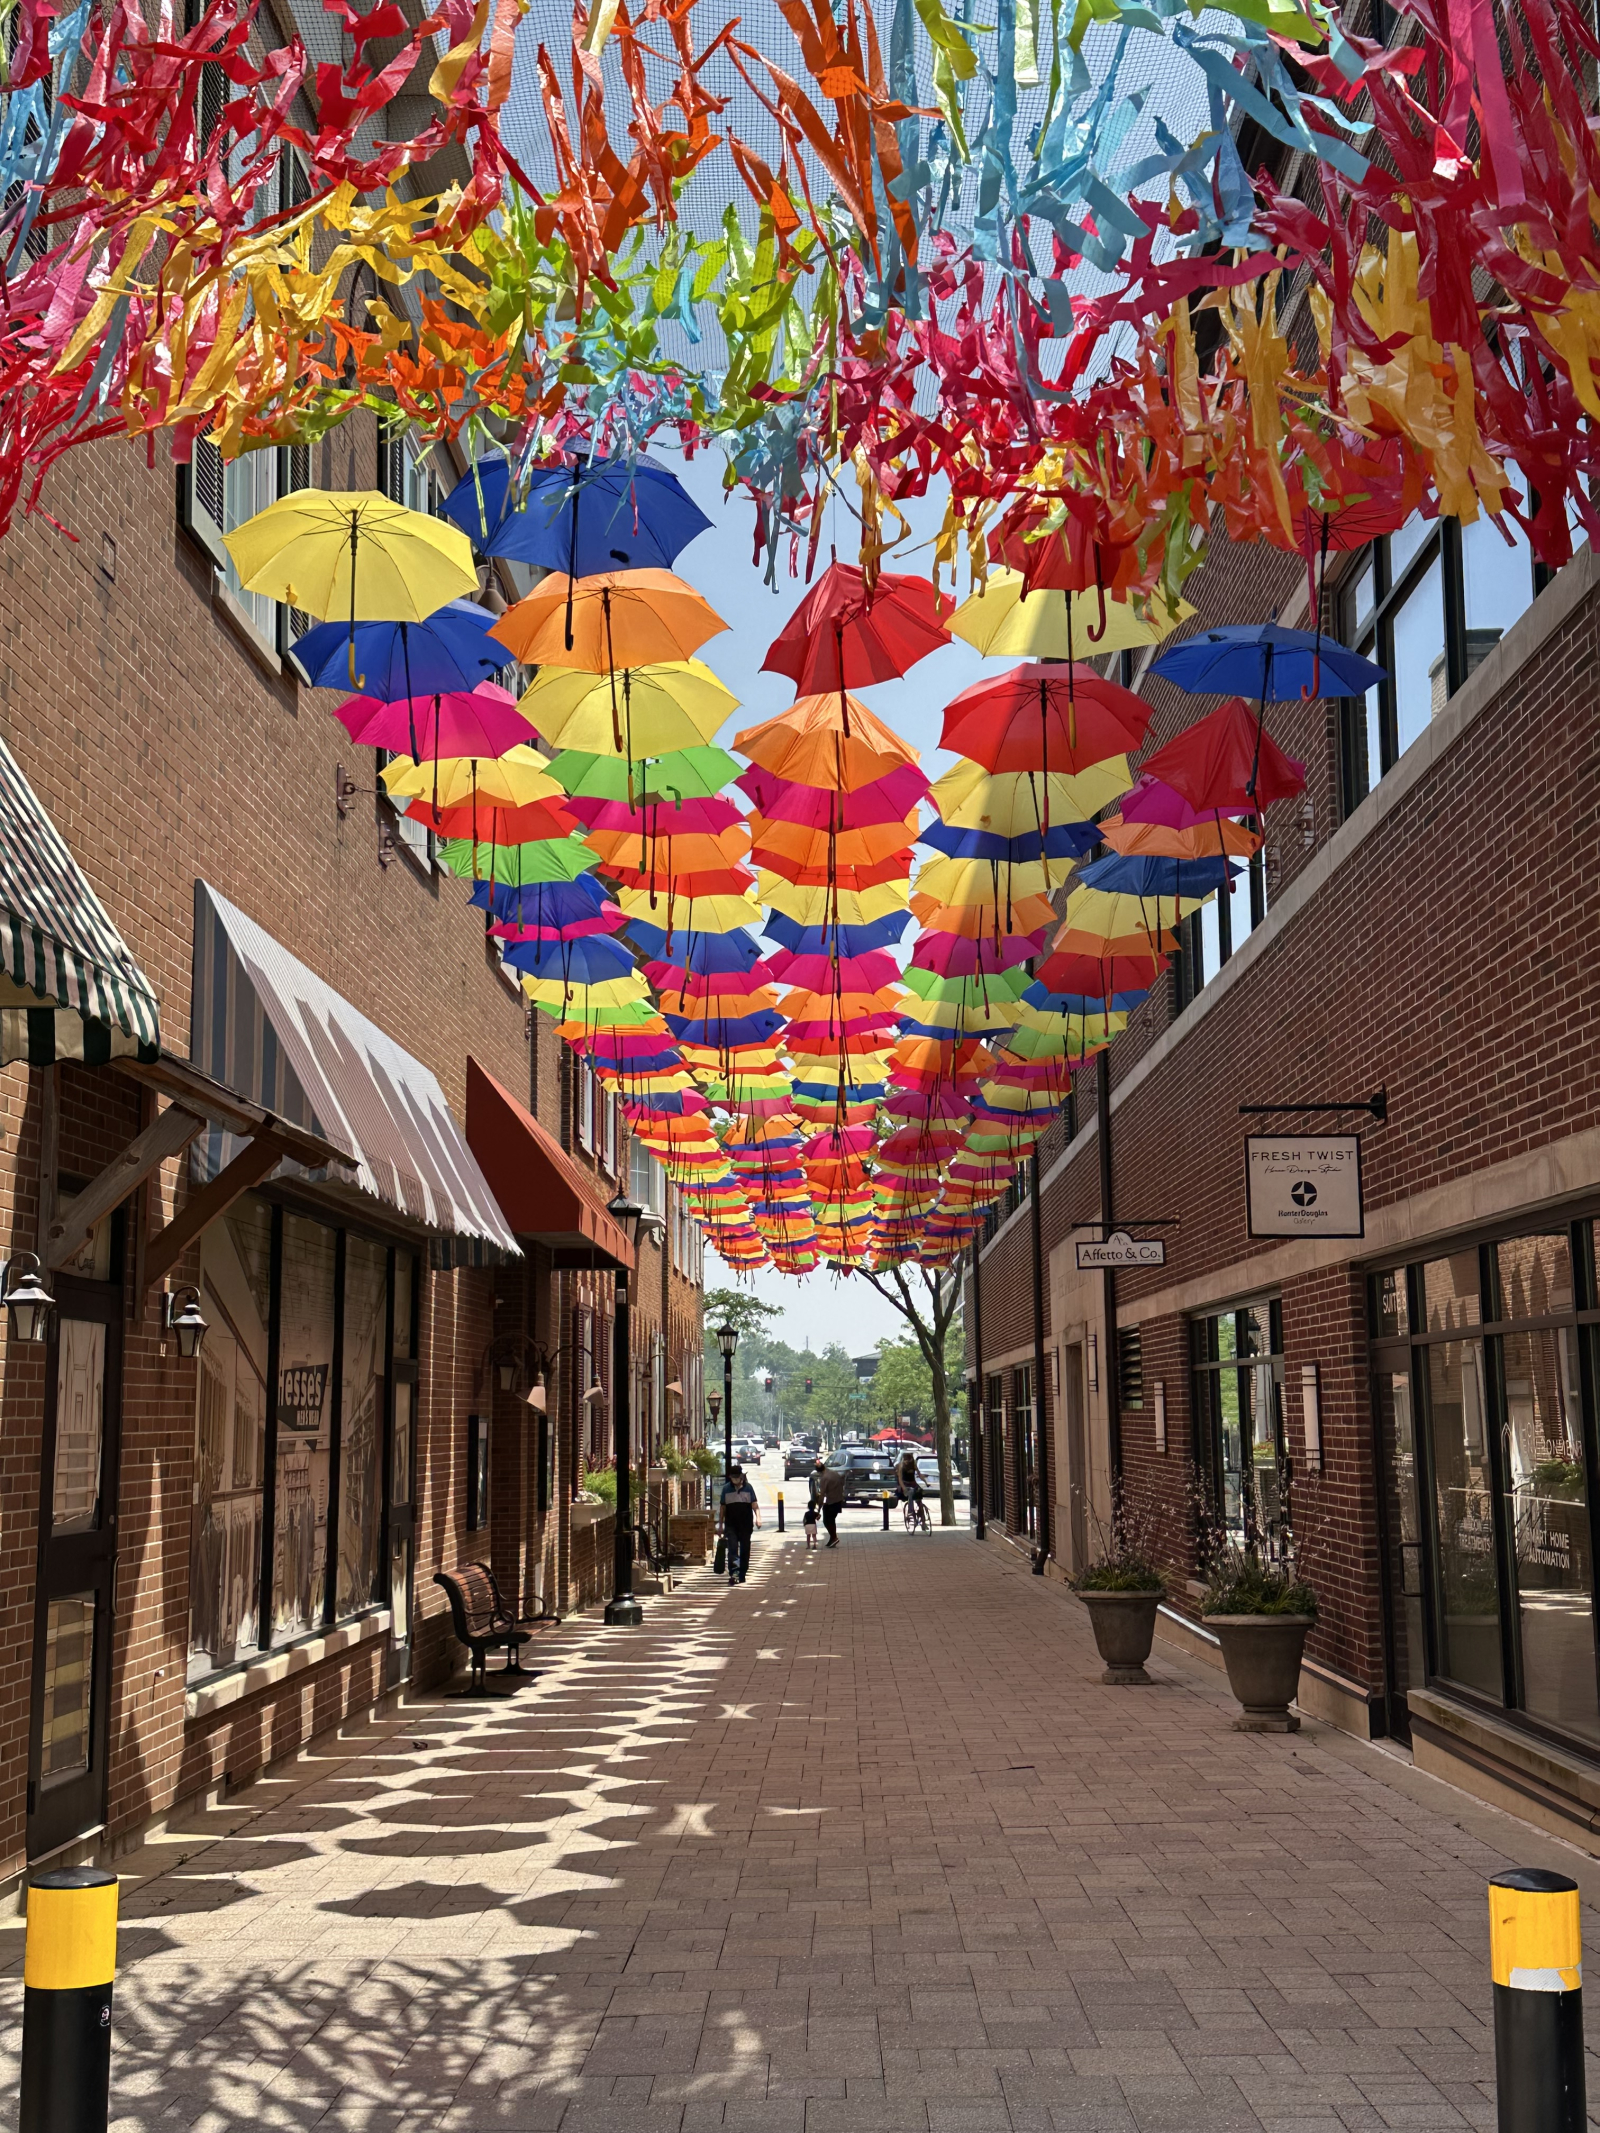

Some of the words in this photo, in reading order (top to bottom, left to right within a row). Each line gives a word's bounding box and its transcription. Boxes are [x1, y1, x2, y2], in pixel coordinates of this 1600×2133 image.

[1252, 1151, 1301, 1161] FRESH
[1307, 1150, 1354, 1161] TWIST
[1082, 1247, 1123, 1261] Affetto
[1125, 1247, 1137, 1259] &
[1139, 1246, 1161, 1259] Co.
[277, 1364, 322, 1407] Hesse's
[1526, 1528, 1547, 1546] SMART
[1549, 1530, 1570, 1549] HOME
[1528, 1547, 1570, 1570] AUTOMATION
